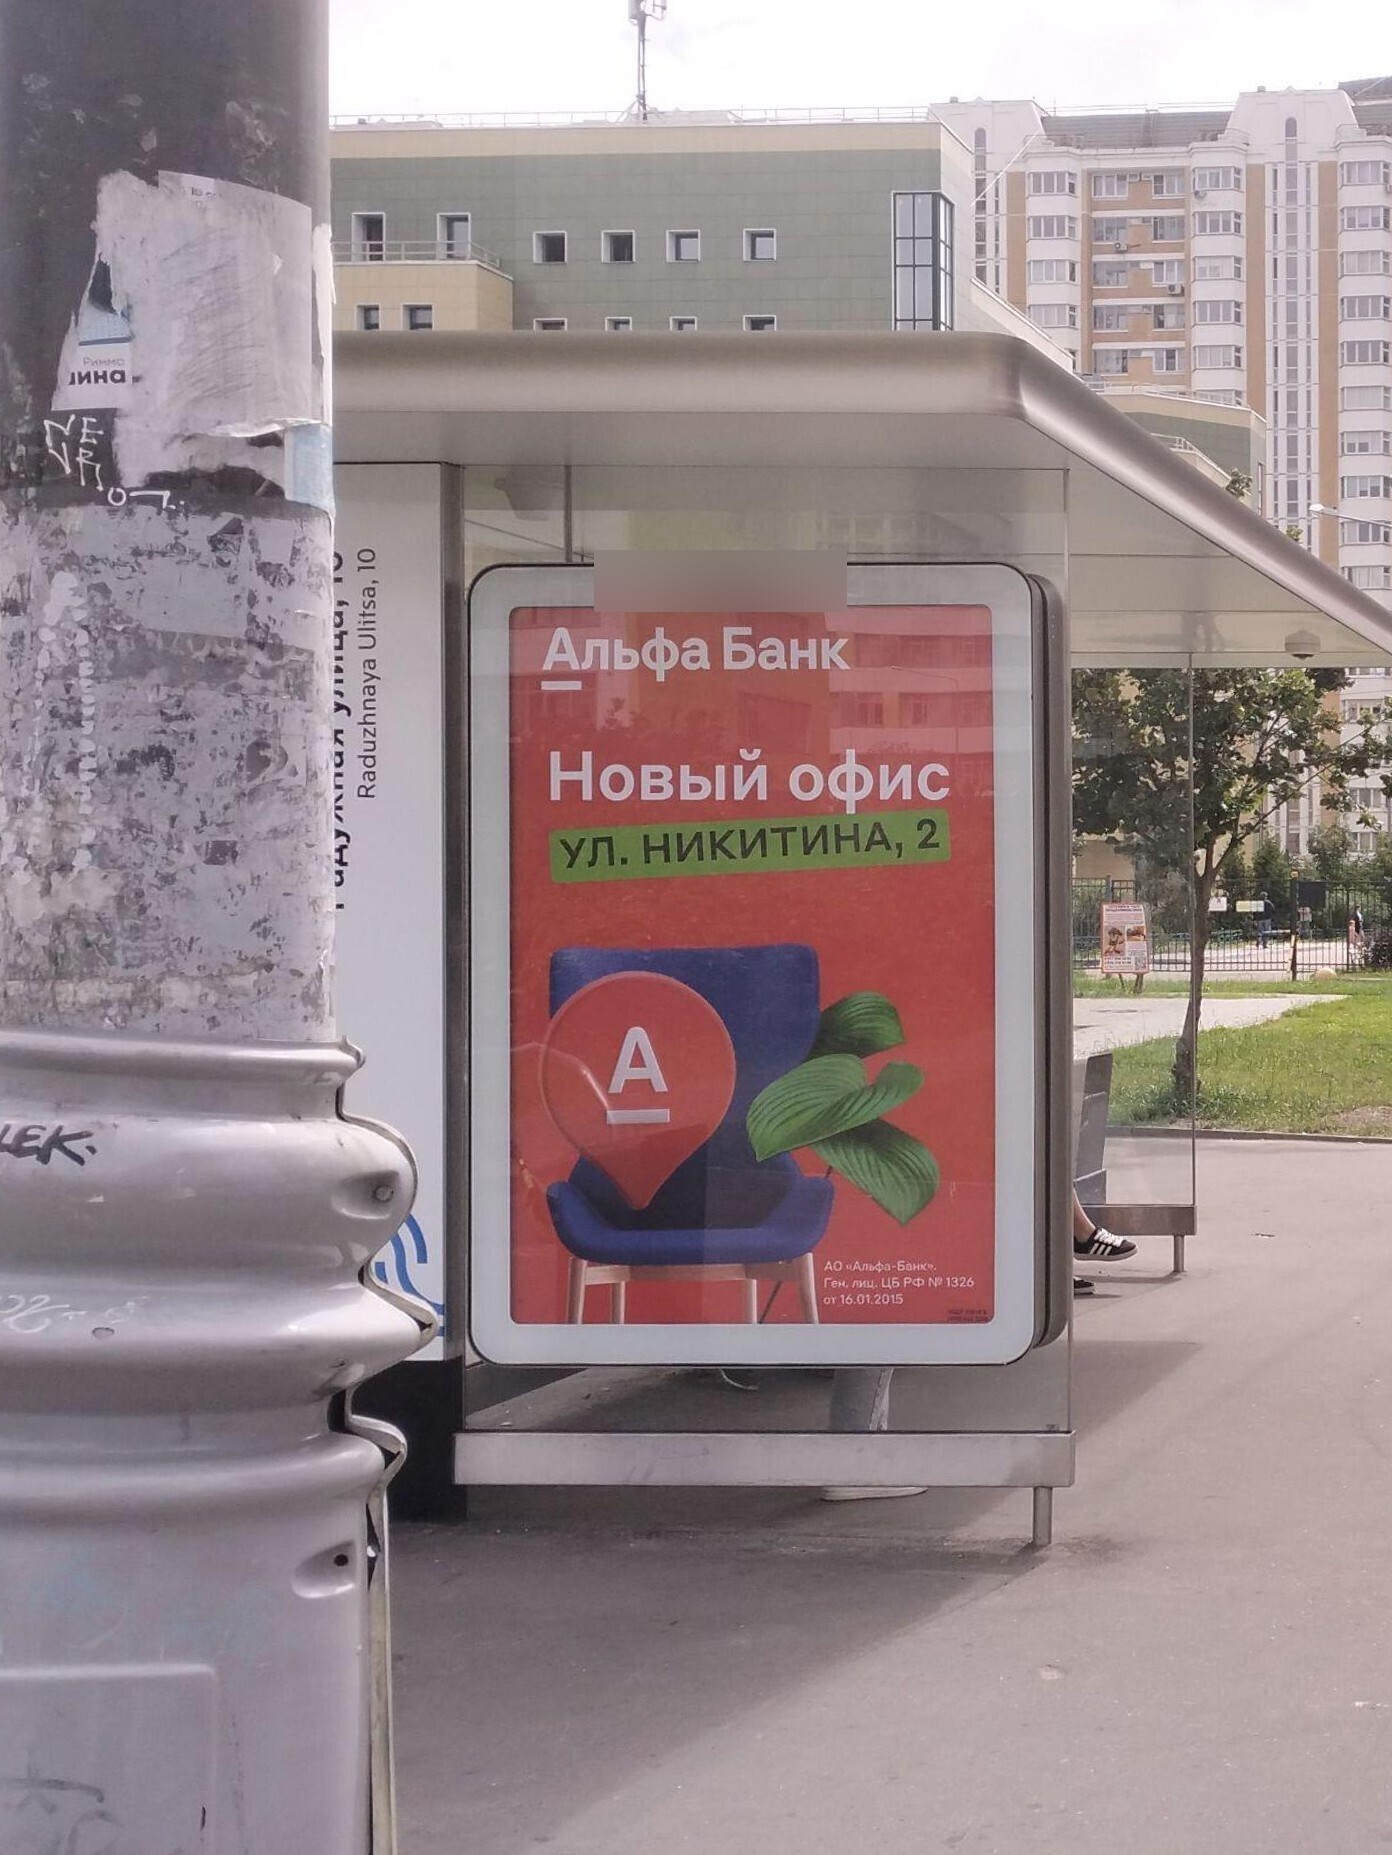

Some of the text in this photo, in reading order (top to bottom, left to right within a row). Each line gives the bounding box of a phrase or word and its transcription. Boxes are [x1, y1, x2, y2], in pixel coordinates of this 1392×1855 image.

[357, 548, 382, 799] Raduzhnaya Ulitsa, 10
[542, 627, 851, 682] Альфа Банк
[549, 748, 951, 814] Новый офис
[558, 818, 941, 869] УЛ. НИКИТИНА, 2
[823, 1276, 975, 1291] Ген. лиц. ЦБ РФ № 1326
[824, 1261, 843, 1272] АО
[823, 1294, 904, 1306] от 16.01.2015
